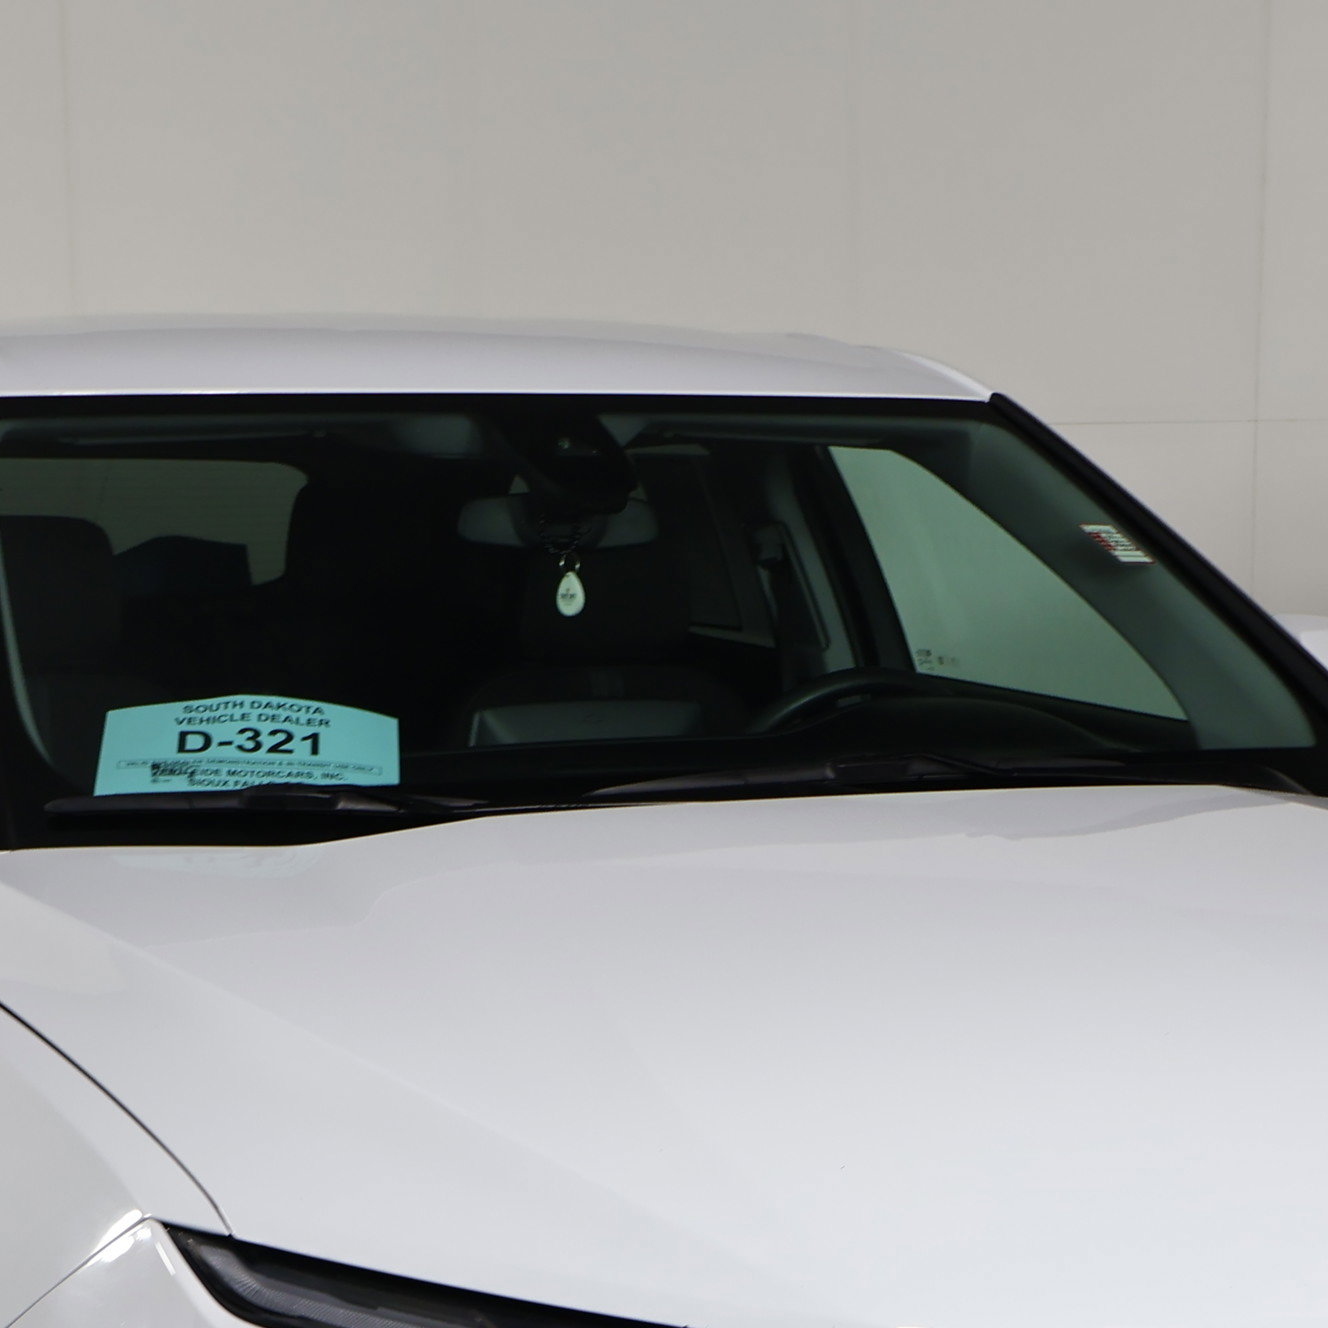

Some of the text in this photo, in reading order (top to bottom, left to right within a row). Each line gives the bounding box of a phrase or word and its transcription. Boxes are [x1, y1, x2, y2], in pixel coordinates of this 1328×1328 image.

[182, 700, 326, 716] SOUTH DAKOTA
[174, 712, 331, 728] VEHICLE DEALER
[177, 727, 320, 756] D-321
